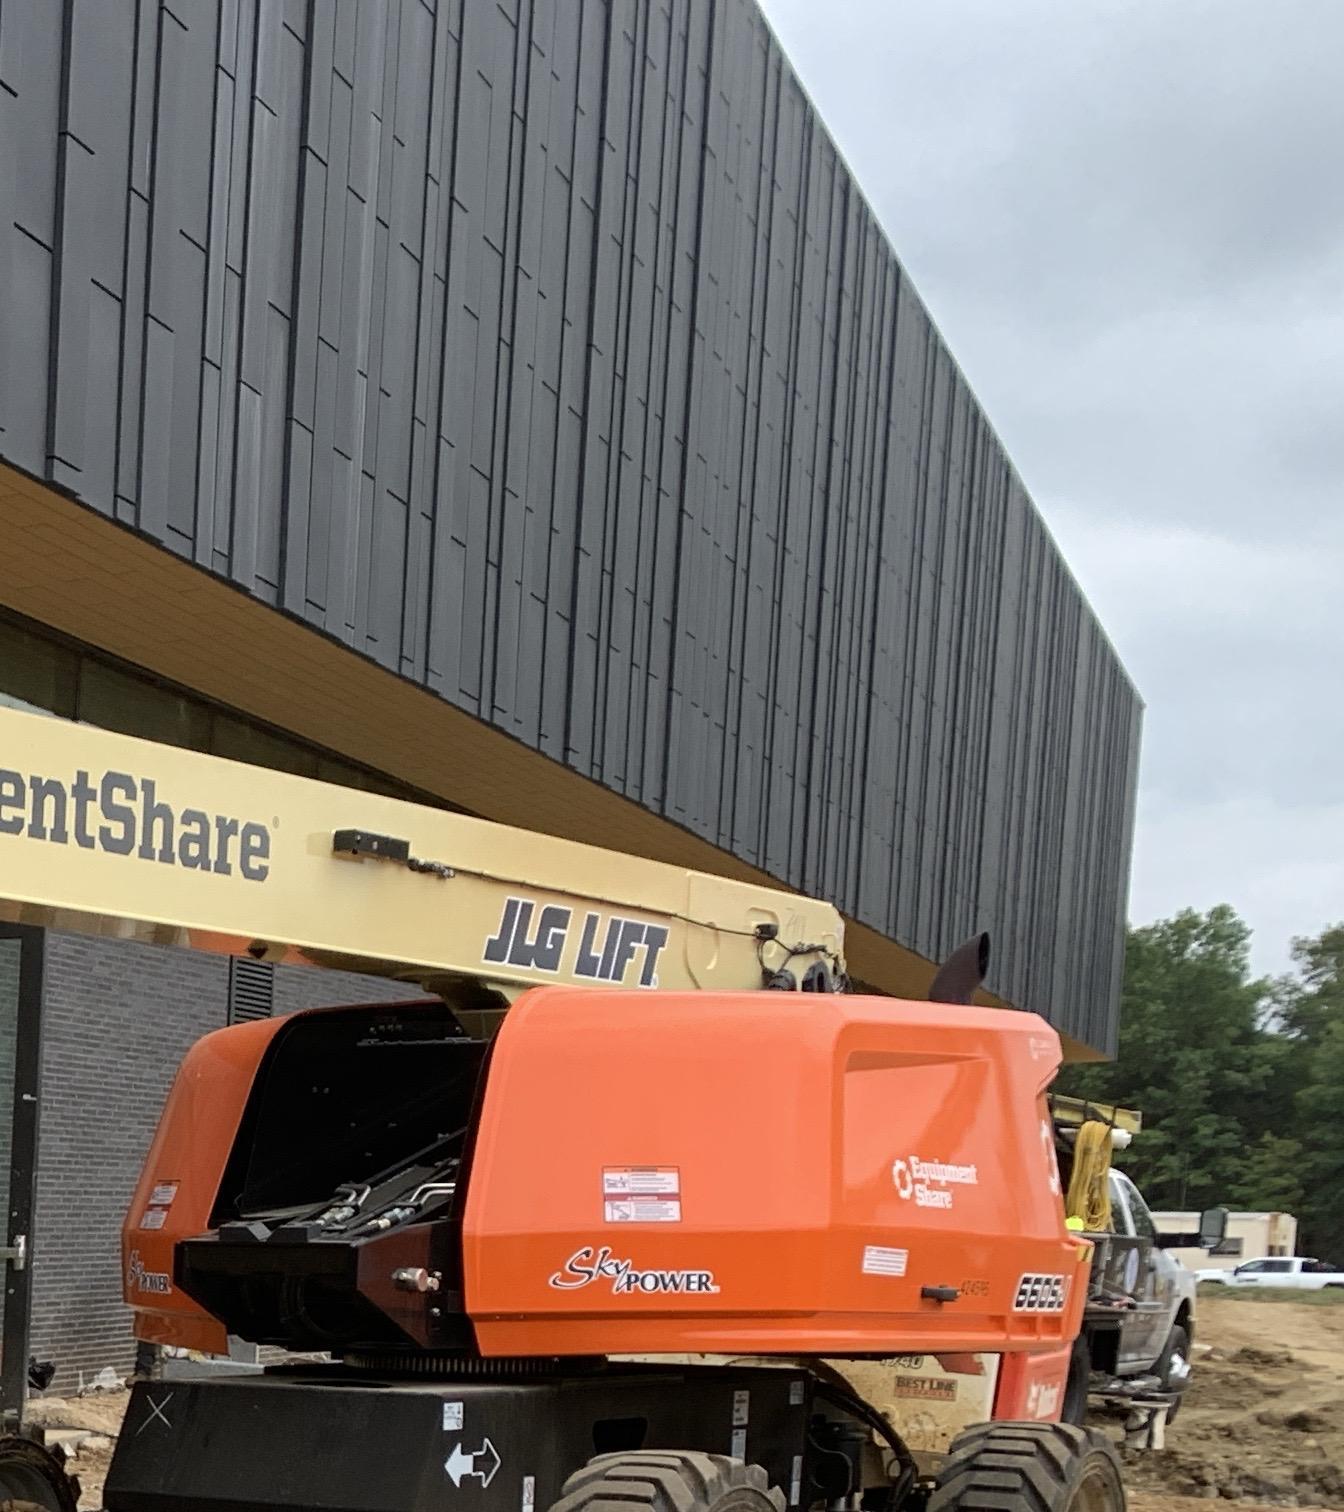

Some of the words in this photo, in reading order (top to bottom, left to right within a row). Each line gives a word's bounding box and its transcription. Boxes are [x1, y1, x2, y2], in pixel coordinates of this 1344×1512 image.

[482, 896, 573, 973] JLG
[573, 907, 671, 988] LIFT
[908, 1156, 978, 1187] Equipment
[914, 1183, 953, 1209] Share
[896, 1375, 927, 1390] BEST
